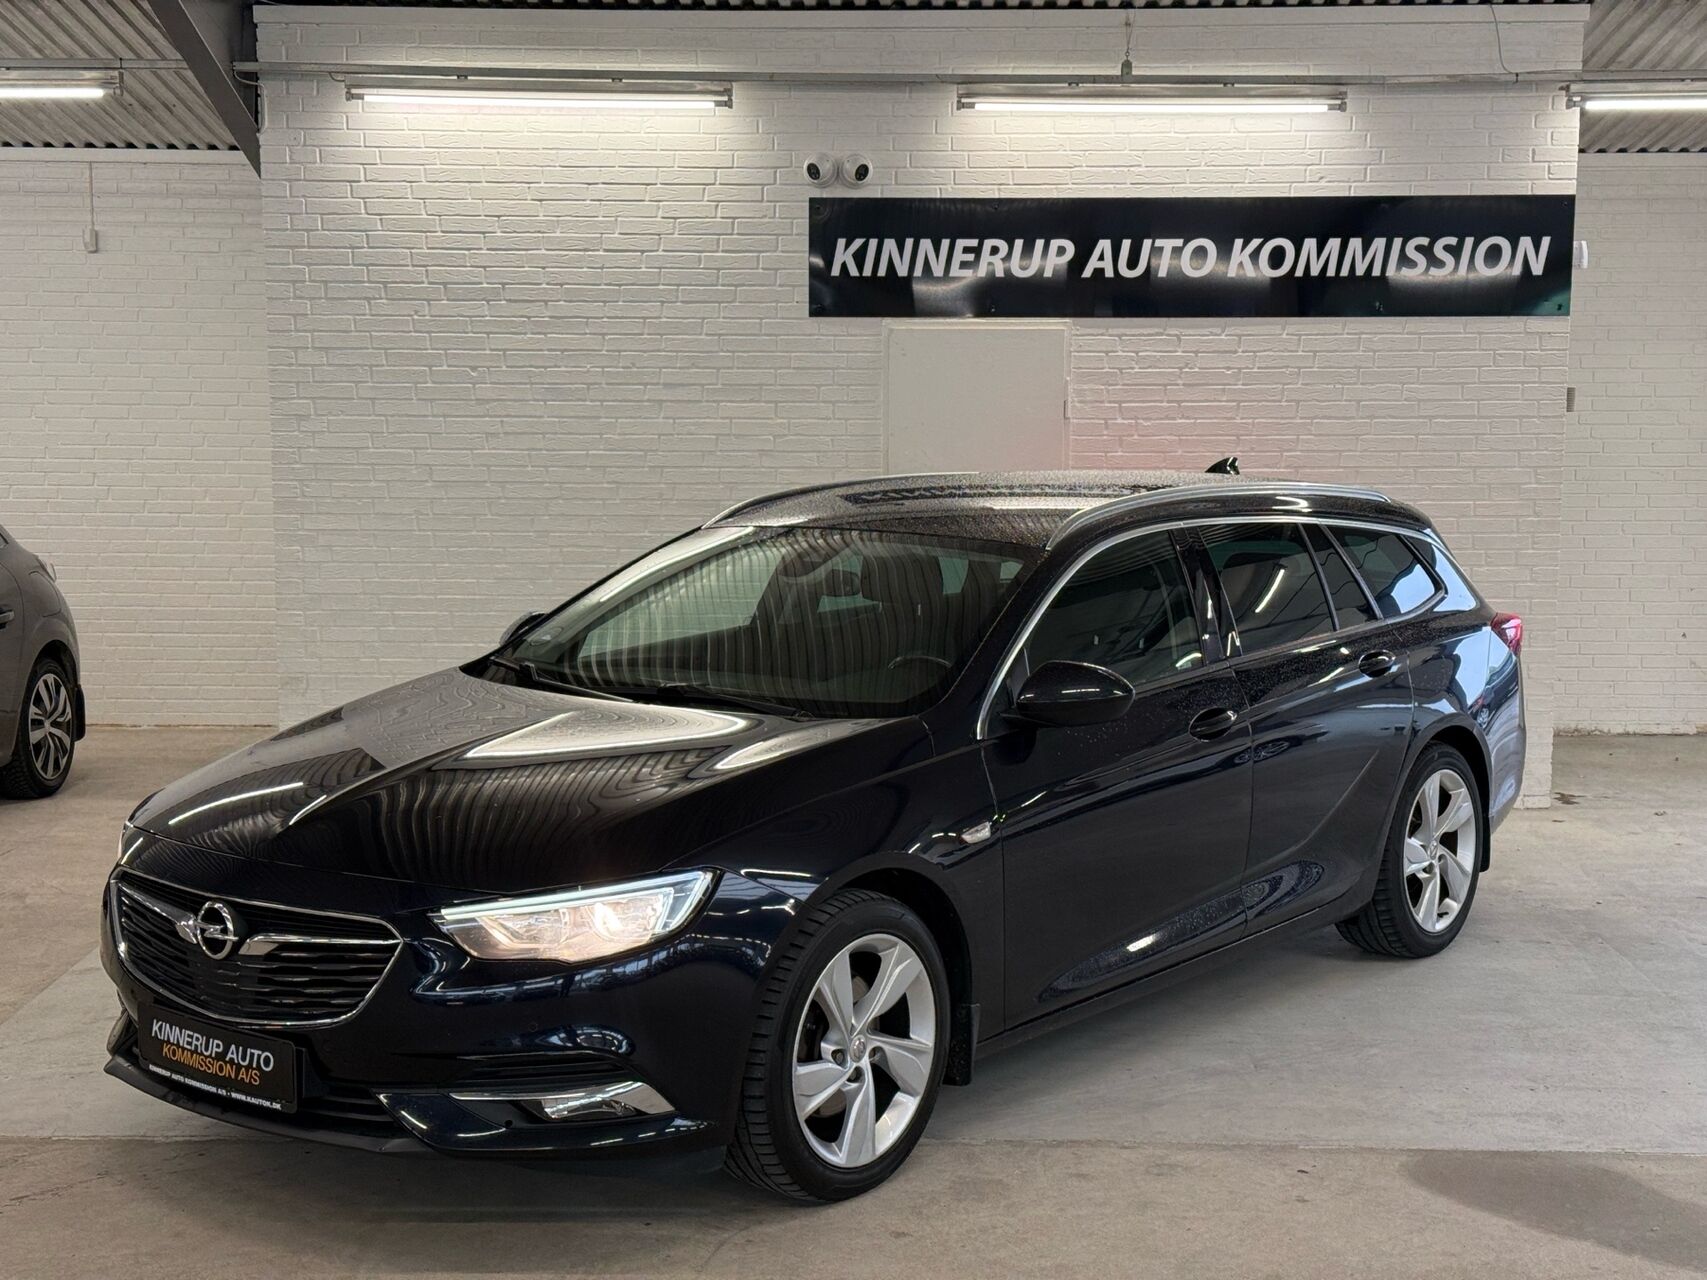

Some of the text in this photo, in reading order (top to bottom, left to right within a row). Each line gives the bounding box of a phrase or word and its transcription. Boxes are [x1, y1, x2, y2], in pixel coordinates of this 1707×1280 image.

[830, 235, 1552, 278] KINNERUP AUTO KOMMISSION
[151, 1018, 274, 1072] KINNERUP AUTO
[162, 1042, 260, 1086] KOMMISSION A/S
